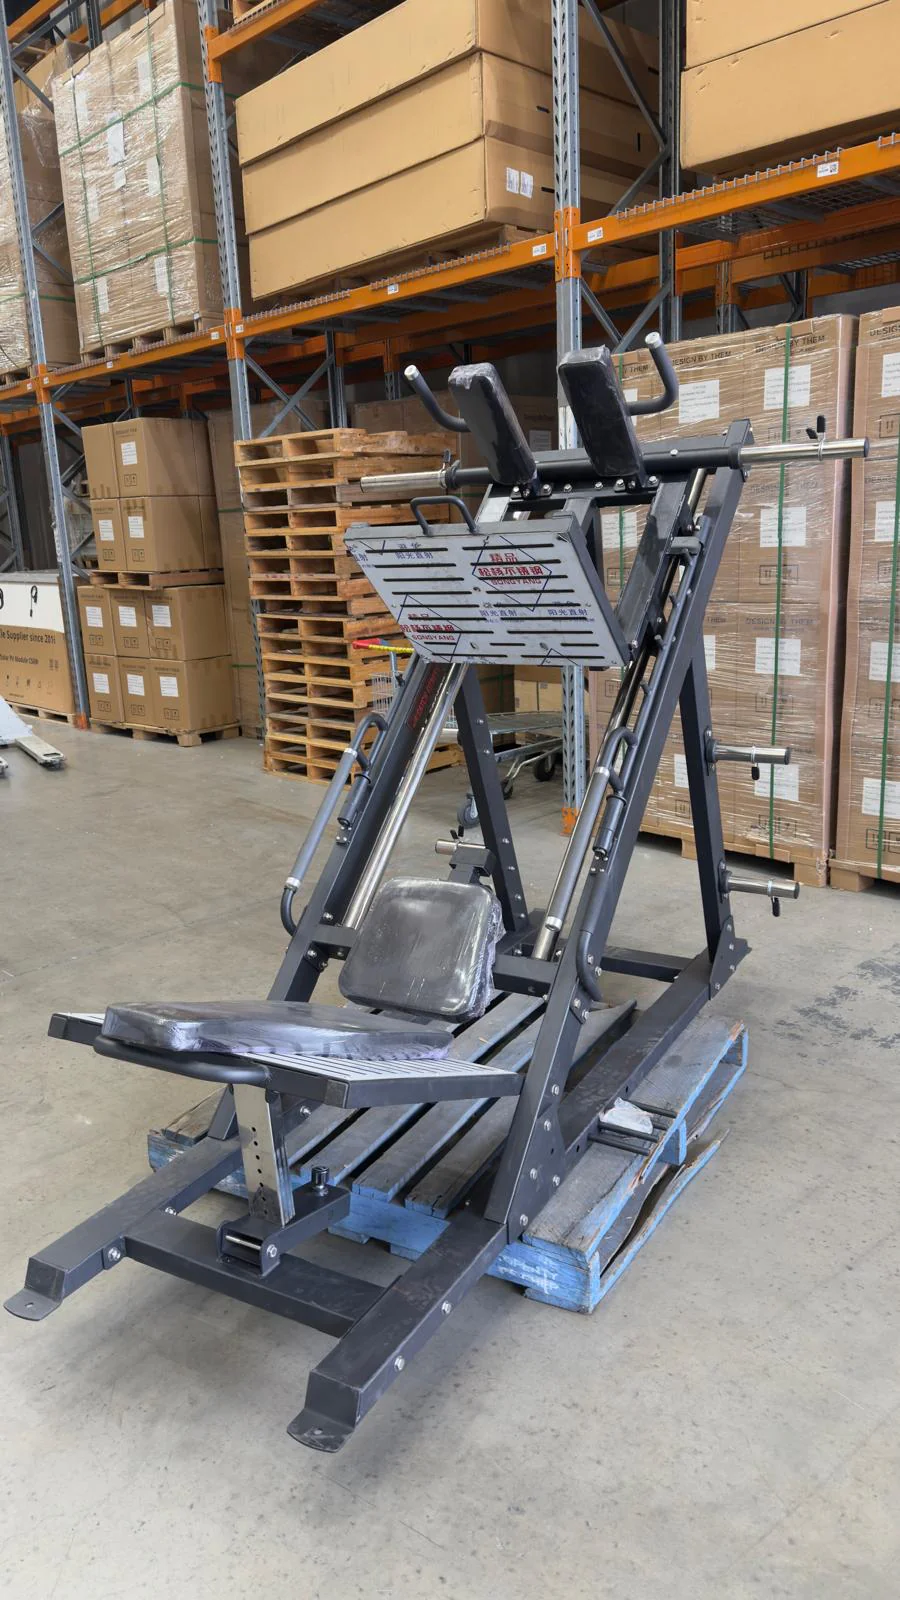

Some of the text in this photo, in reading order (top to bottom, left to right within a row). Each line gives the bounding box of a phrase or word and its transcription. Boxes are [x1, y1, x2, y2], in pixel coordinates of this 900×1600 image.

[870, 325, 900, 337] DESIG
[802, 335, 825, 345] THEM
[630, 364, 648, 373] THEM
[7, 630, 28, 642] Supplier
[30, 634, 43, 643] since
